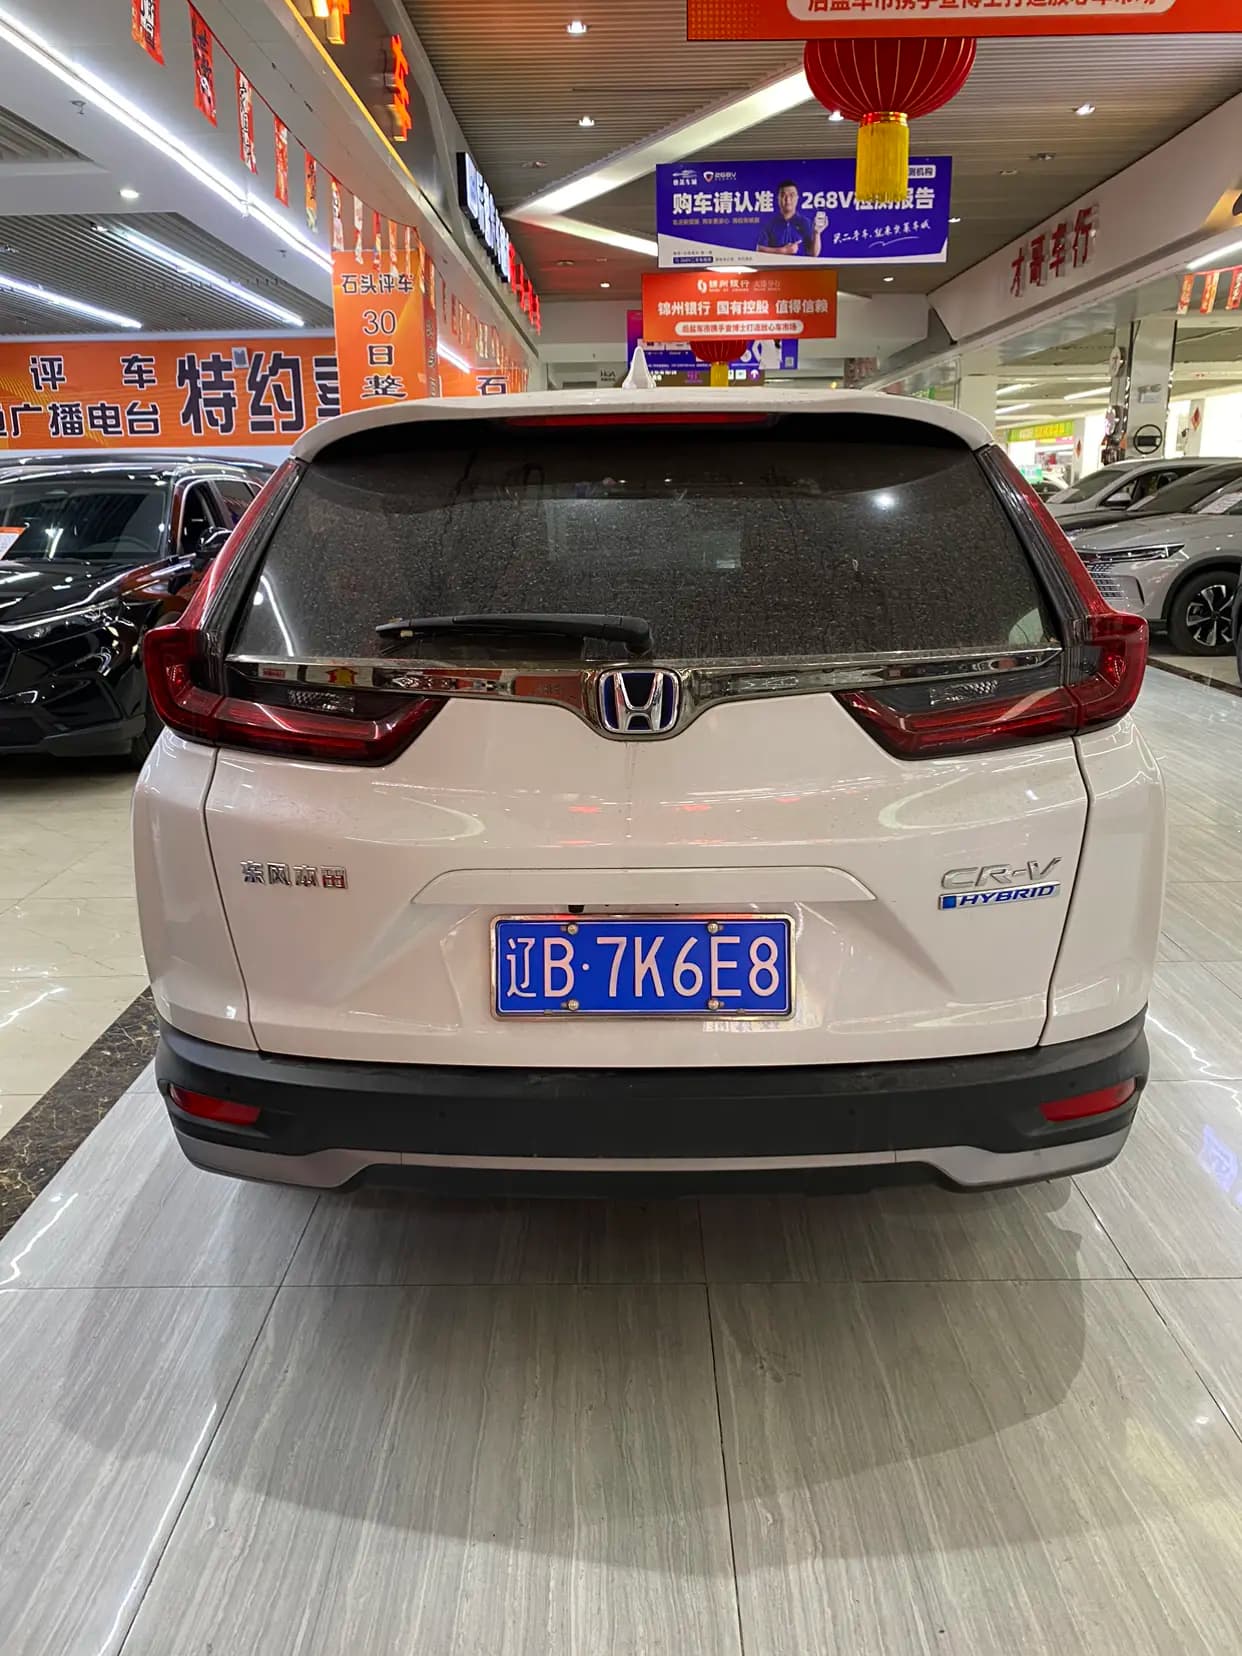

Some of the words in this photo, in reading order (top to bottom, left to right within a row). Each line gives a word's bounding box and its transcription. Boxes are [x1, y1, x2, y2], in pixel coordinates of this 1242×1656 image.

[672, 190, 774, 215] 购车请认准
[341, 274, 415, 294] 石头评车
[657, 301, 710, 316] 锦州银行
[716, 300, 769, 315] 国有控股
[775, 299, 828, 314] 值得信赖
[240, 860, 349, 889] 东风本田
[941, 856, 1063, 890] CR-V
[958, 885, 1058, 907] HYBRID
[505, 935, 781, 999] 辽B·7K6E8
